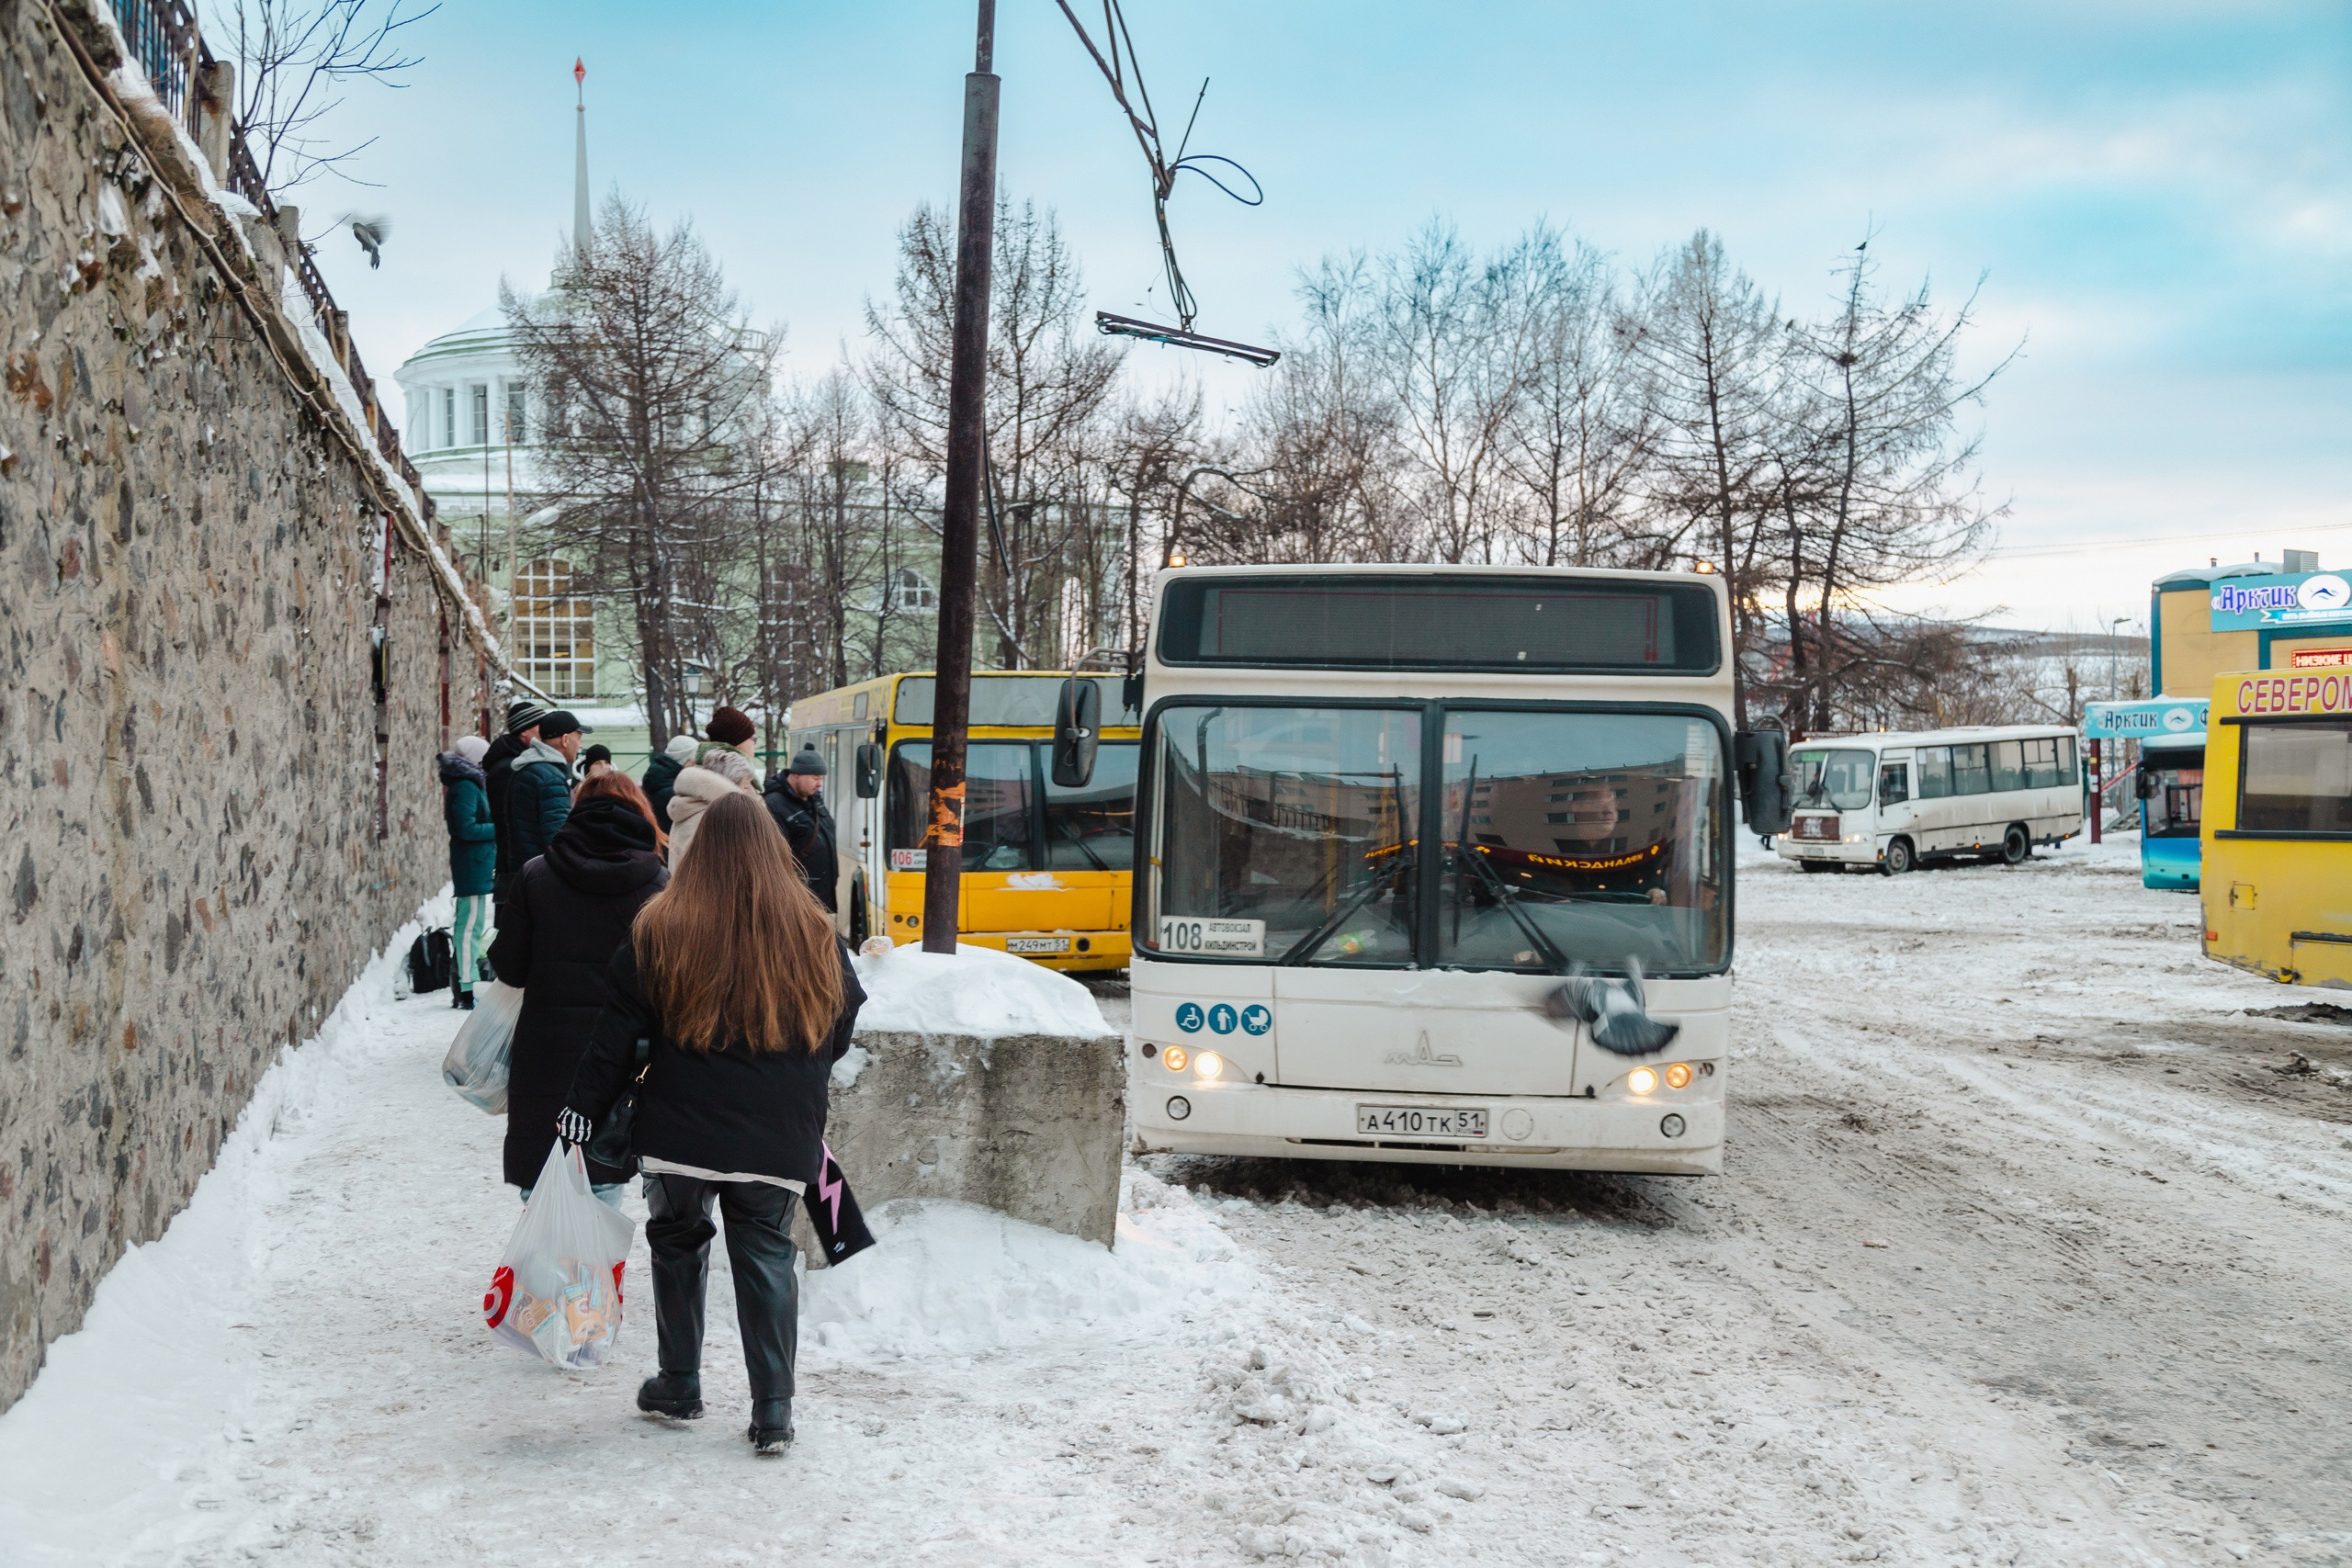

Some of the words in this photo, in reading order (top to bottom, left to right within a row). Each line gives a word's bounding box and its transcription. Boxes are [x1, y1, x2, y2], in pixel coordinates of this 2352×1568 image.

[2296, 653, 2342, 668] НИЗКИЕ
[892, 851, 912, 865] 106
[1162, 921, 1202, 951] 108
[1458, 1112, 1479, 1128] 51
